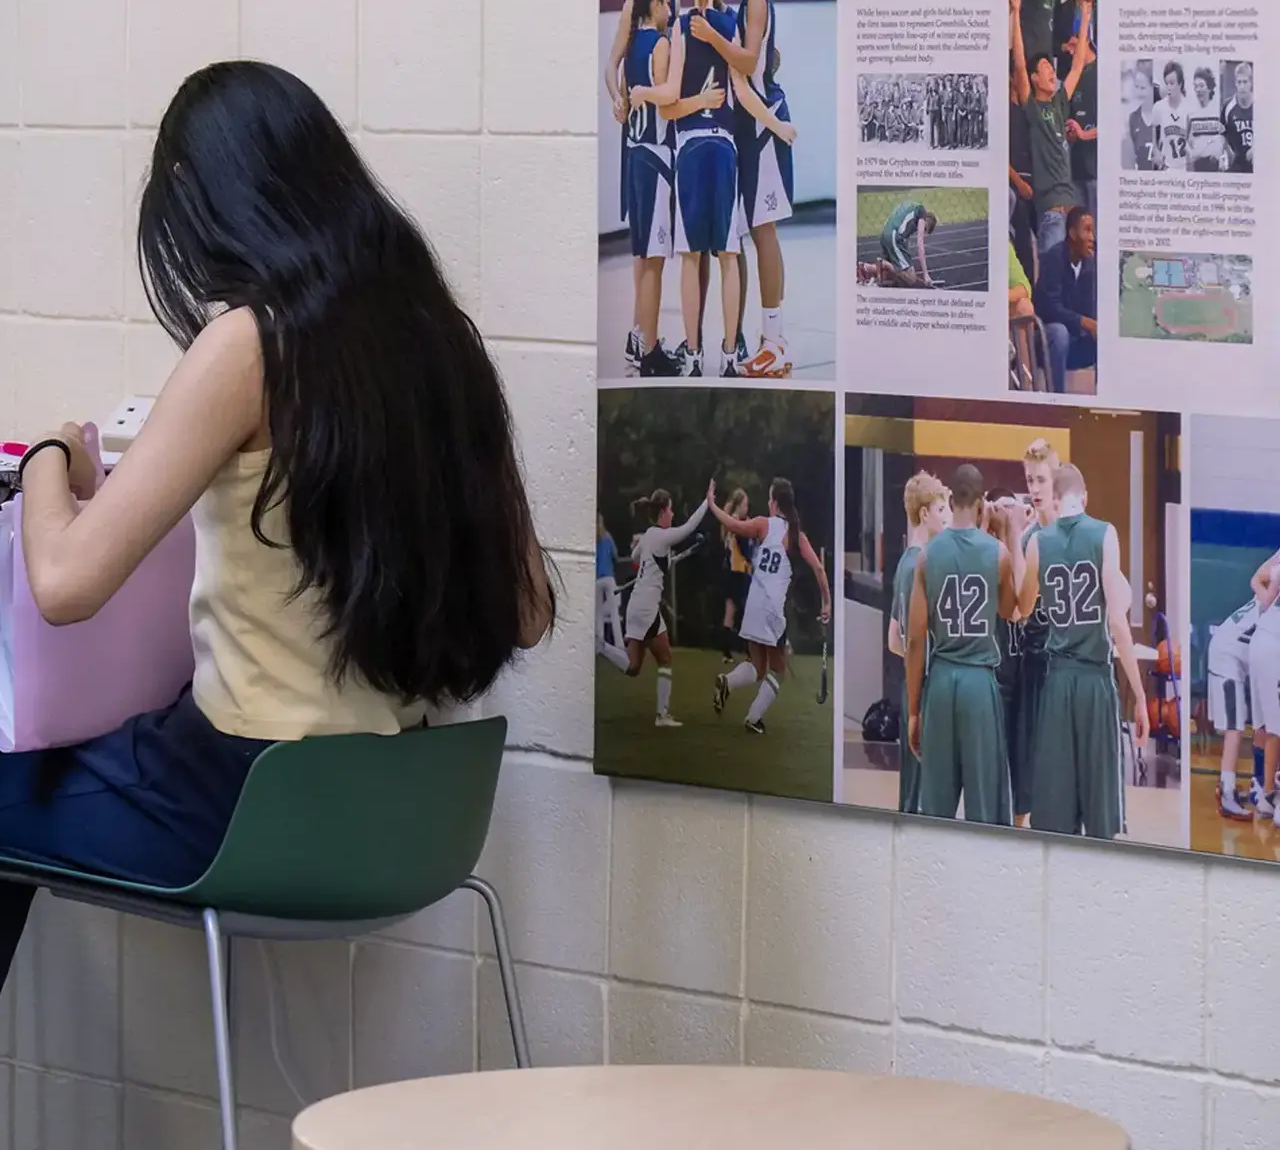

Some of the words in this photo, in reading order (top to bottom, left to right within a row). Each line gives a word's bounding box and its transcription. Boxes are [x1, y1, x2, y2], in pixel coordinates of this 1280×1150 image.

[758, 547, 782, 575] 28
[1045, 559, 1102, 627] 32
[936, 574, 989, 638] 42
